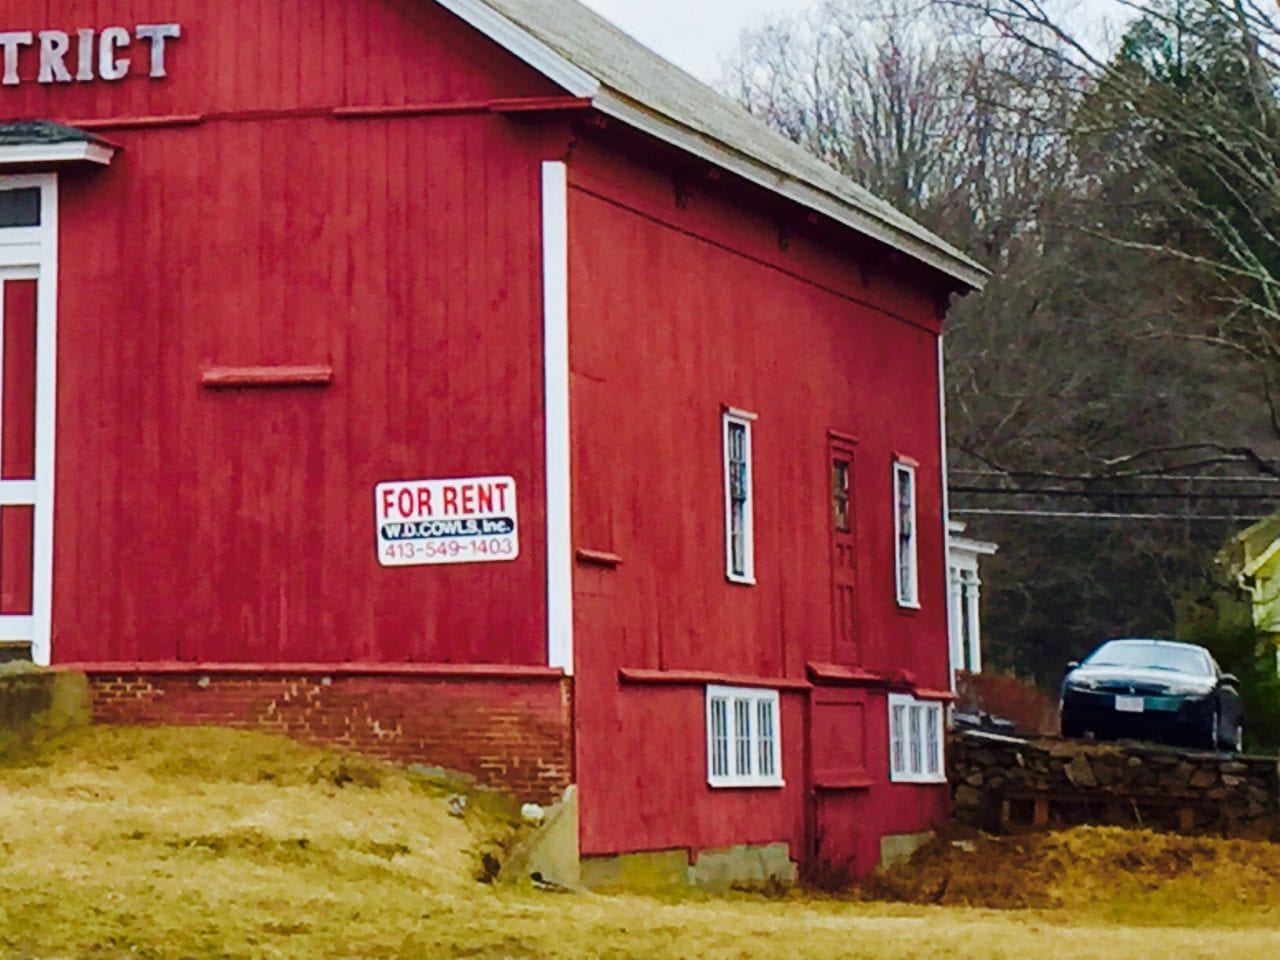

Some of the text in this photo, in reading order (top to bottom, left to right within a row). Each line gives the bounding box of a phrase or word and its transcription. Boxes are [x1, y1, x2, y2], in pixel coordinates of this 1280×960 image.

[382, 482, 508, 518] FOR RENT
[385, 537, 512, 559] 413-549-1403
